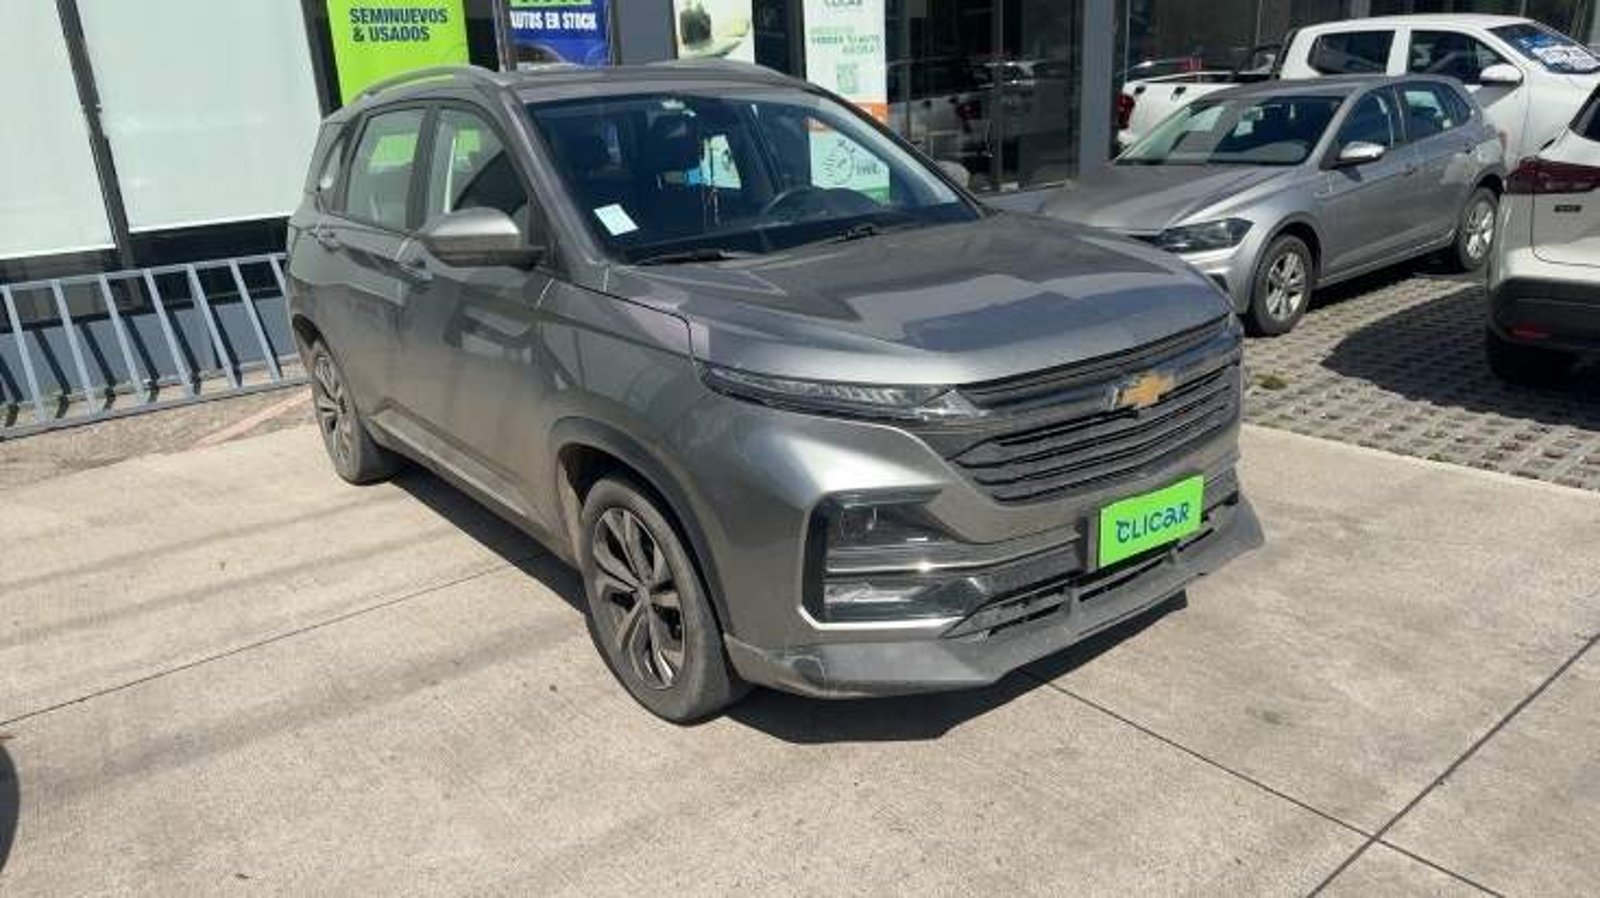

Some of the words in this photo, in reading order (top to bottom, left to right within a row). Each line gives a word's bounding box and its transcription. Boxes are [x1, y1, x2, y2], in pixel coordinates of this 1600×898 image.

[349, 8, 448, 25] SEMINUEVOS
[562, 12, 597, 30] STOCK
[352, 27, 365, 41] &
[369, 26, 431, 41] USADOS
